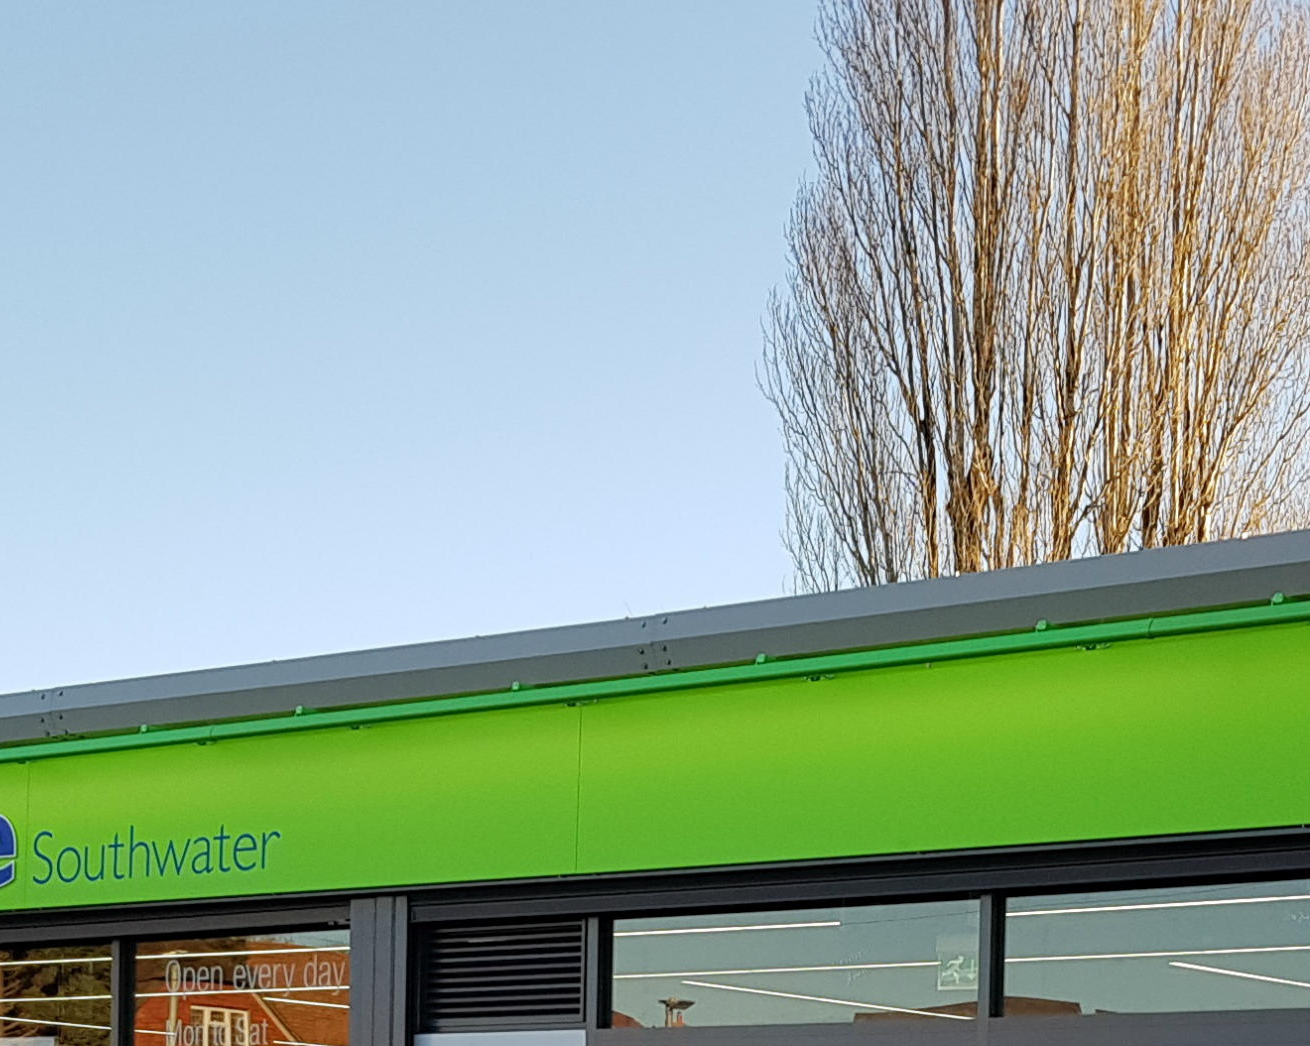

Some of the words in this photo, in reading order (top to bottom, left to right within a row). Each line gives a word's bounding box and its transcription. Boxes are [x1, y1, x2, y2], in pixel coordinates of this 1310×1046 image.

[32, 824, 281, 885] Southwater
[165, 959, 225, 1000] Open
[233, 960, 295, 996] every
[303, 953, 347, 996] day
[165, 1020, 206, 1046] Mon
[235, 1018, 269, 1046] Sat
